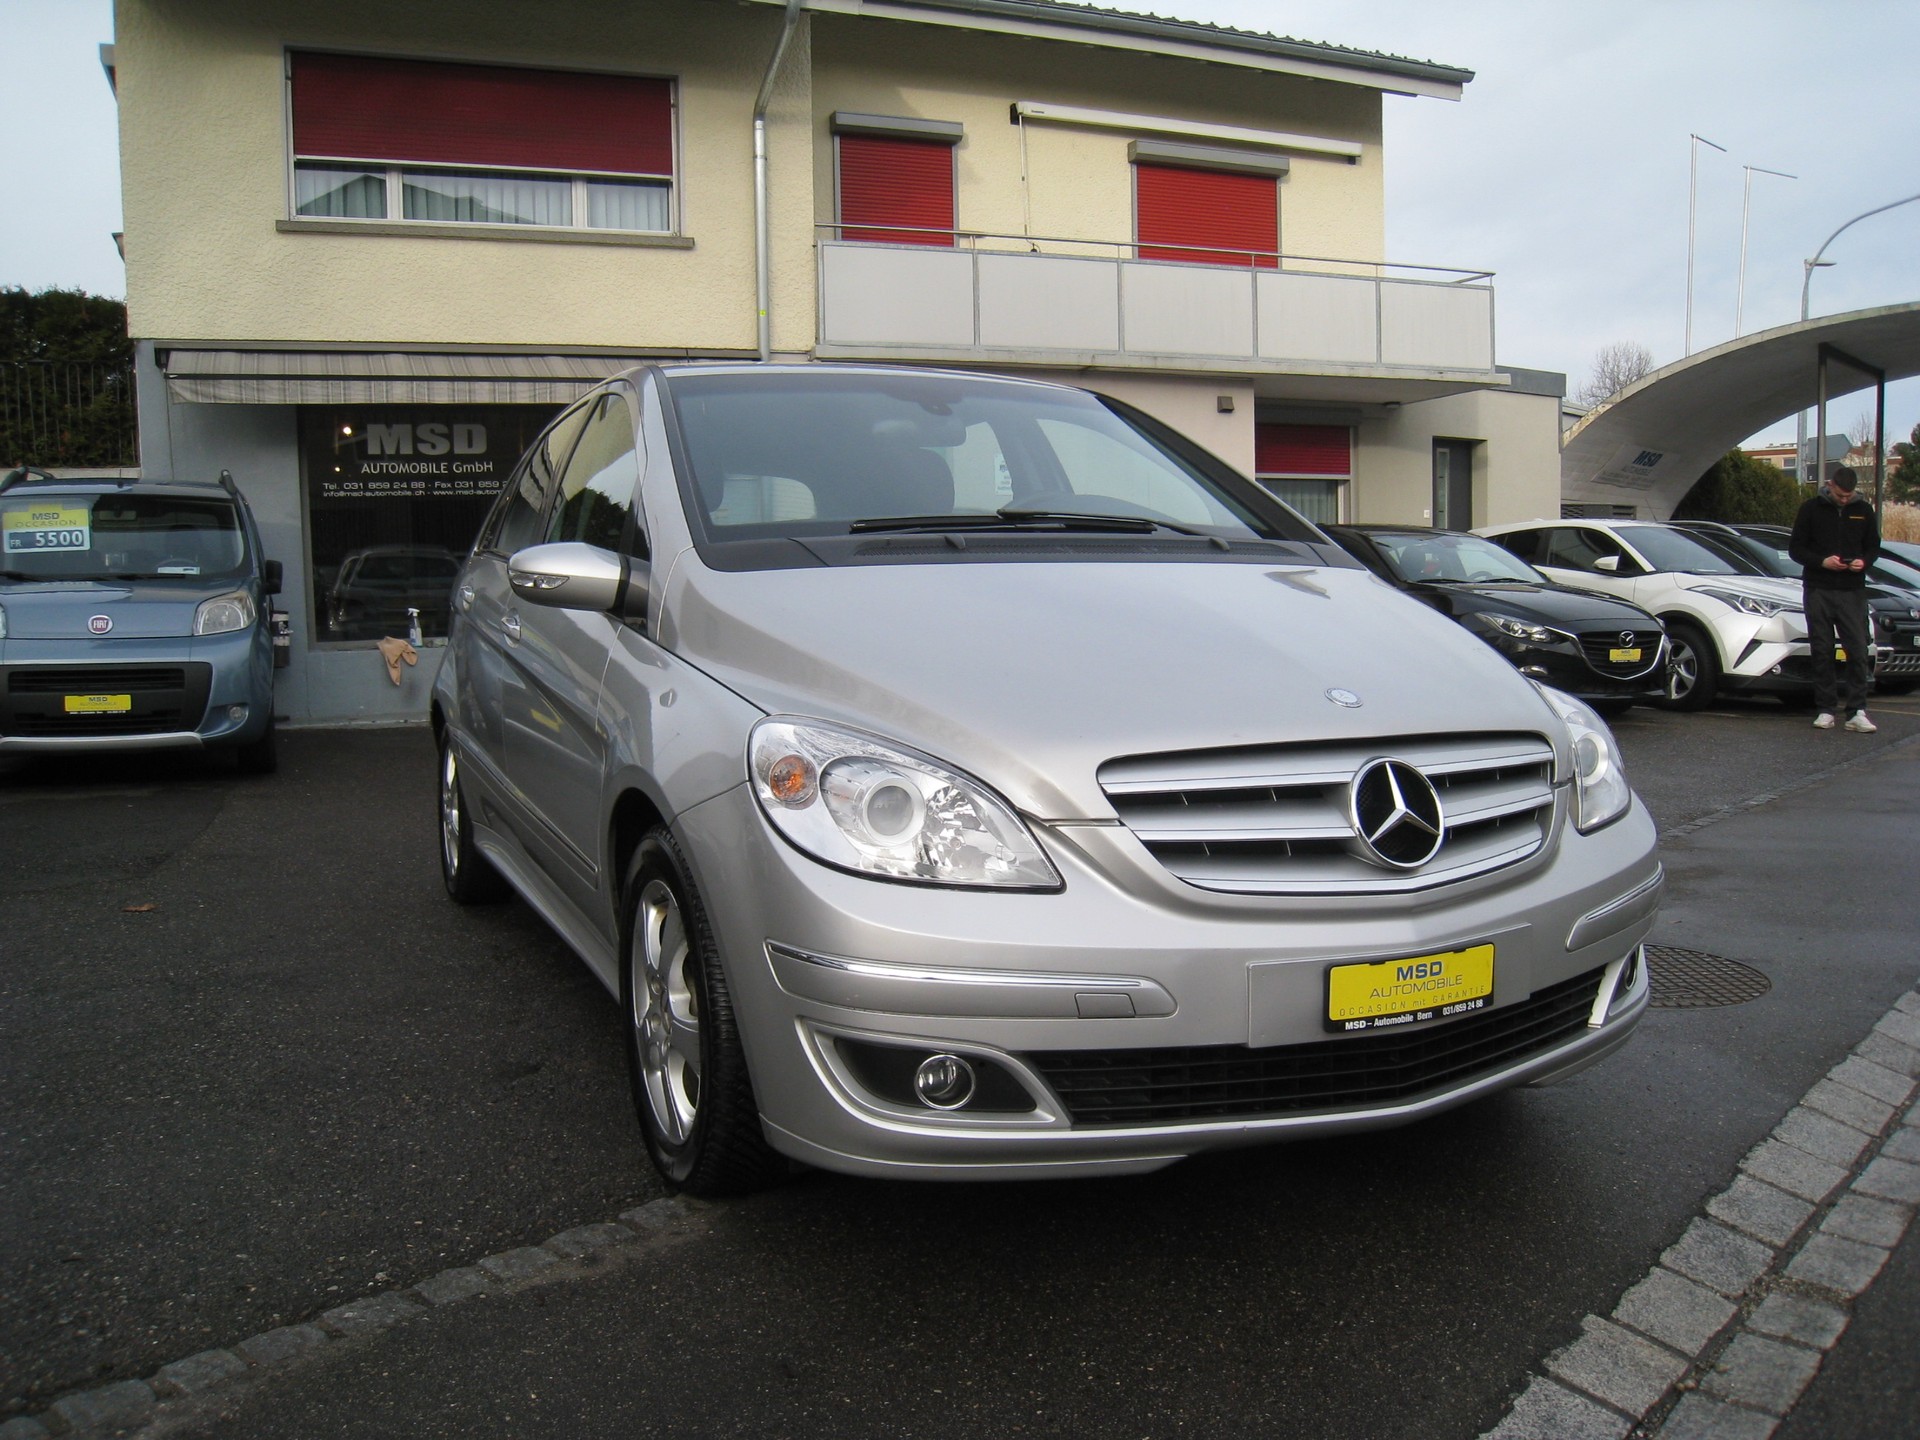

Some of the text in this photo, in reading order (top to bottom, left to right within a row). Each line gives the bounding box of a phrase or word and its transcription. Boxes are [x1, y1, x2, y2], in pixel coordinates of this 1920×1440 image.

[366, 423, 488, 456] MSD
[1632, 450, 1664, 467] MSD
[361, 461, 494, 474] AUTOMOBILE GmbH
[322, 482, 340, 490] Tel.
[343, 482, 364, 490] 031
[368, 482, 390, 490] 859
[393, 481, 408, 489] 24
[478, 480, 500, 488] 859
[15, 519, 77, 528] OCCASION
[32, 512, 60, 521] MSD
[10, 531, 83, 548] FR 5500
[93, 620, 108, 629] FIAT
[1396, 961, 1443, 982] MSD
[1369, 974, 1463, 999] AUTOMOBILE
[1339, 985, 1485, 1016] OCCASION mit GARANTIE
[1373, 1014, 1414, 1027] Automobile
[1417, 1011, 1433, 1021] Bern
[1442, 1003, 1467, 1016] 031/859
[1467, 1000, 1475, 1011] 24
